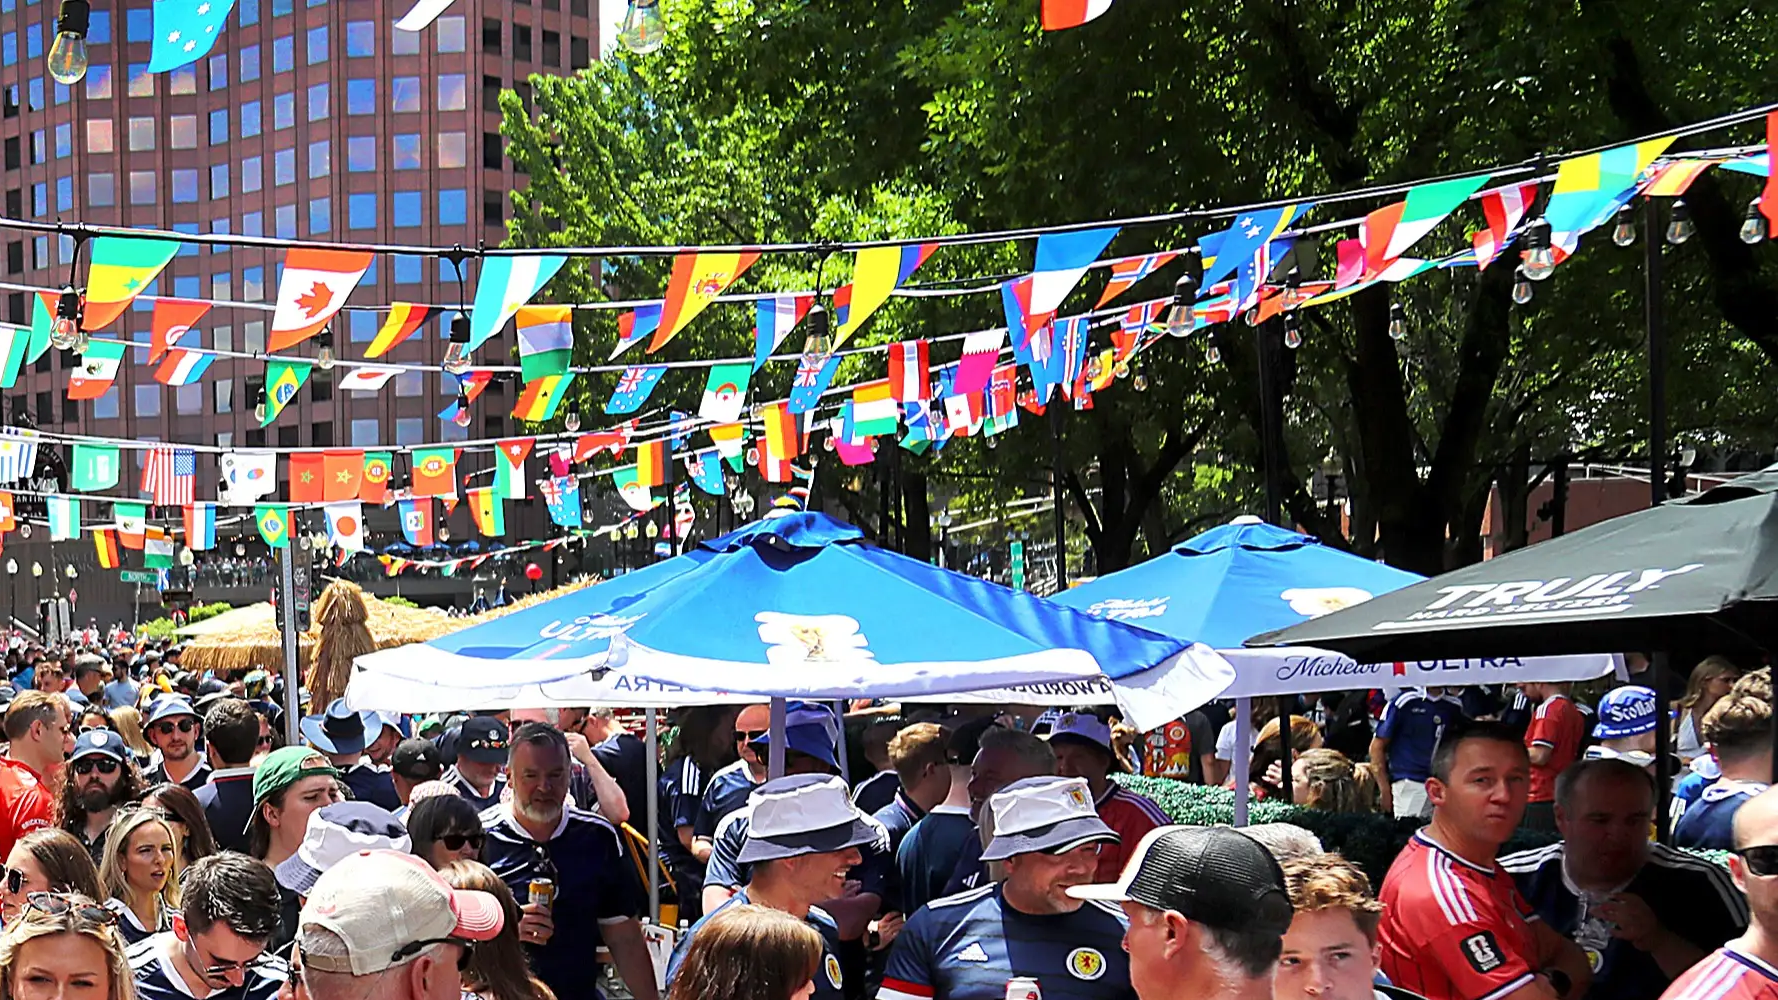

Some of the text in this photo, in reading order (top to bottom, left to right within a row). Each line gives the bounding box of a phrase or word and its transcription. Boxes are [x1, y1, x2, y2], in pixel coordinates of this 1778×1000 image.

[1426, 564, 1704, 609] TRULY
[1408, 593, 1632, 621] HARD SELTZER
